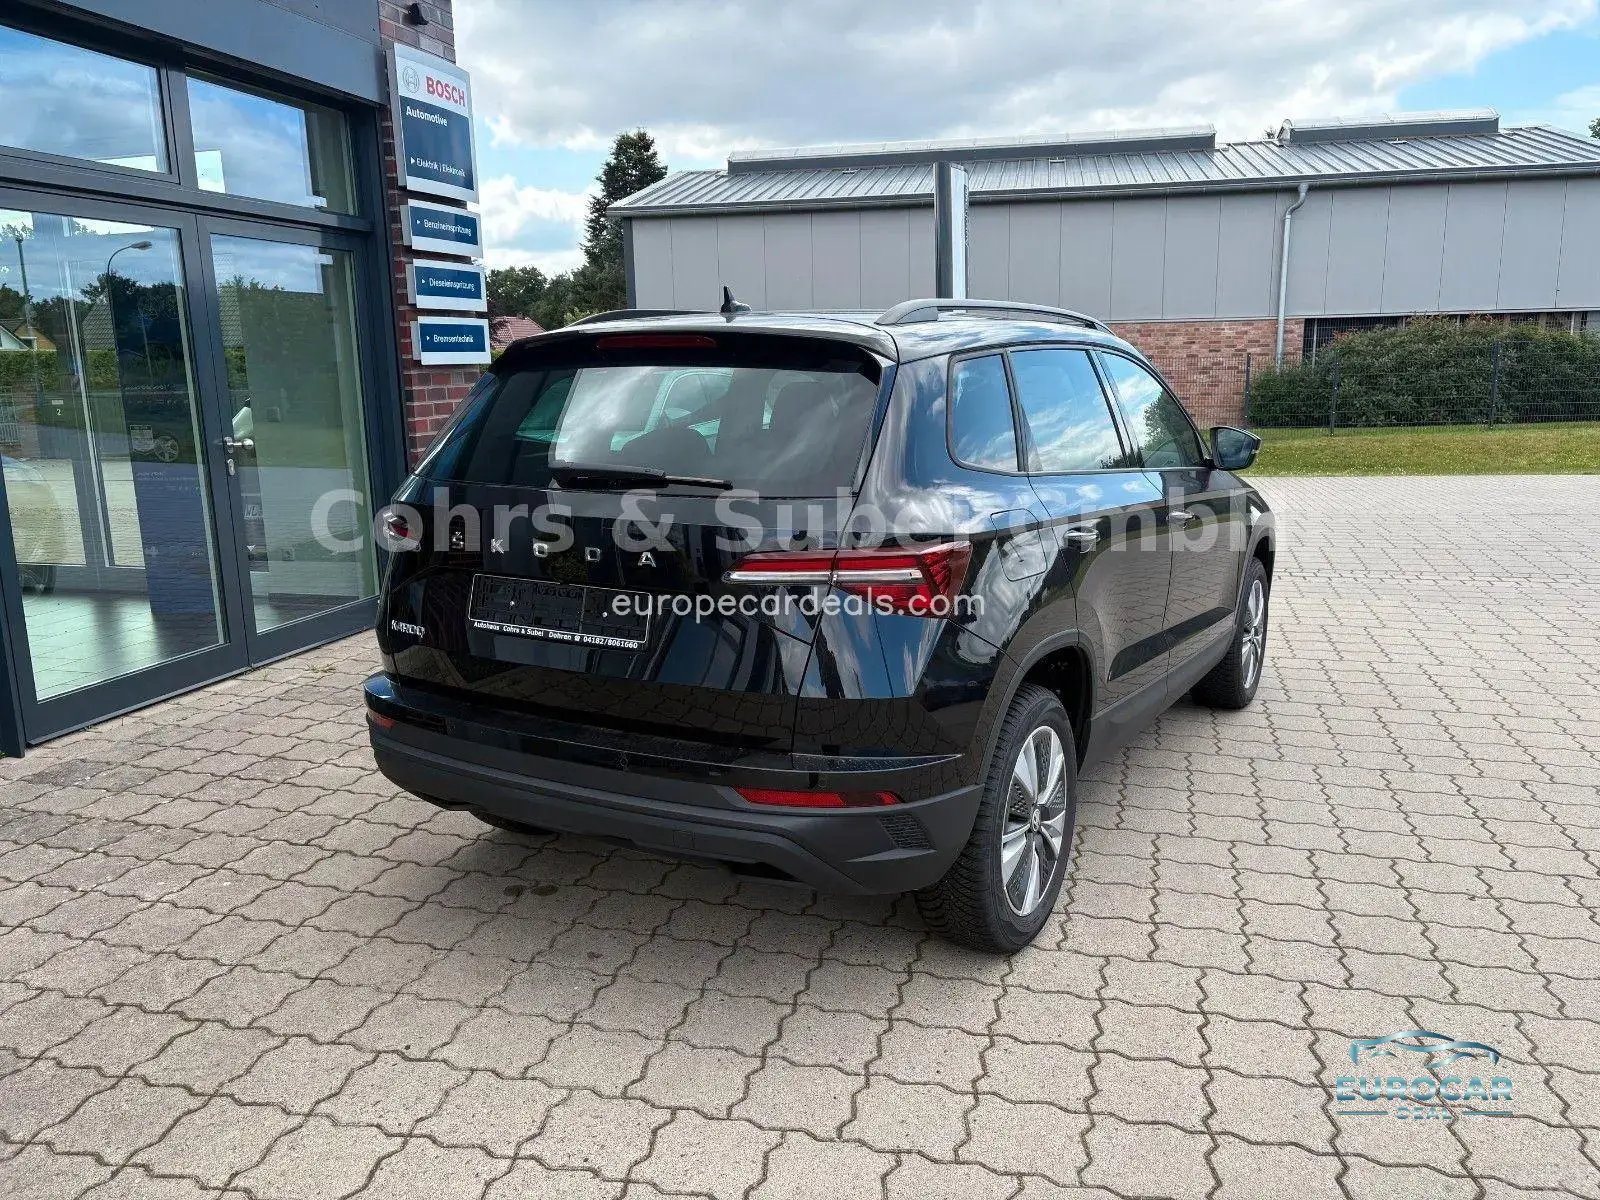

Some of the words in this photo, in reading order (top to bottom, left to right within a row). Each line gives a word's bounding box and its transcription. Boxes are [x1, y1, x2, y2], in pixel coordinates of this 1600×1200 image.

[426, 75, 466, 107] BOSCH
[406, 105, 448, 126] Automotive
[416, 157, 439, 170] Elektrik
[442, 163, 466, 177] Elektronik
[424, 219, 472, 237] Benzineinspritzung
[429, 277, 475, 292] Dieseleinspritzung
[433, 334, 474, 343] Bremsentechnik
[473, 621, 500, 631] Autohaus
[503, 625, 520, 636] Cohrs
[548, 631, 572, 641] Dohren
